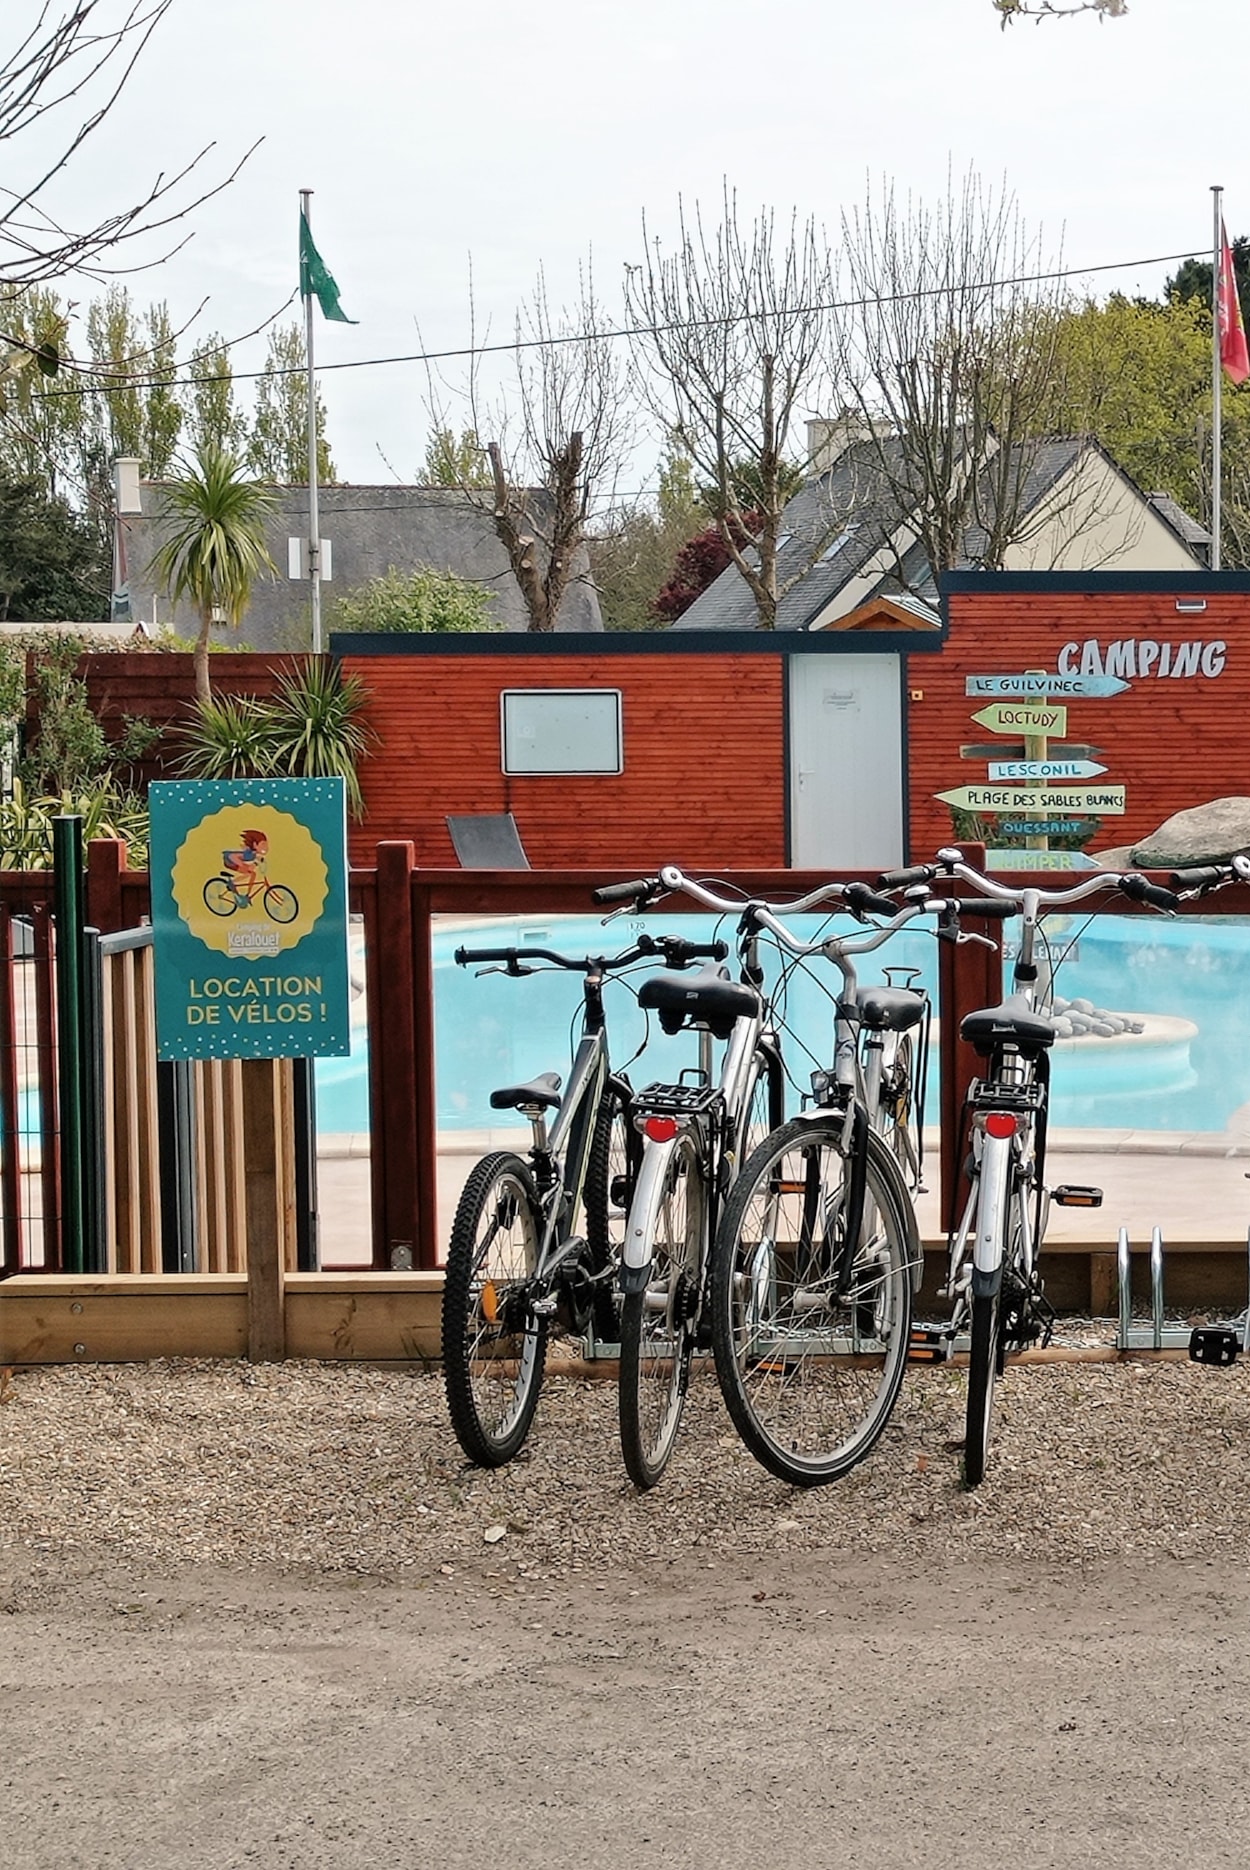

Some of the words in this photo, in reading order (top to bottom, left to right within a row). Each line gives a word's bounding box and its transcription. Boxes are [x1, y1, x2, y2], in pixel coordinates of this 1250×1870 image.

[1056, 638, 1228, 679] CAMPING
[975, 679, 993, 691] LE
[1000, 679, 1084, 692] GUILVINEC
[998, 710, 1059, 728] LOCTUDY
[998, 764, 1082, 777] LESCONIL
[968, 791, 1010, 806] PLAGE
[1013, 794, 1036, 806] DES
[1041, 794, 1081, 807] SABLES
[1003, 822, 1081, 833] OUESSANT
[189, 976, 322, 998] LOCATION
[187, 1005, 220, 1025] DE
[227, 998, 313, 1024] VÉLOS
[320, 1003, 327, 1022] !
